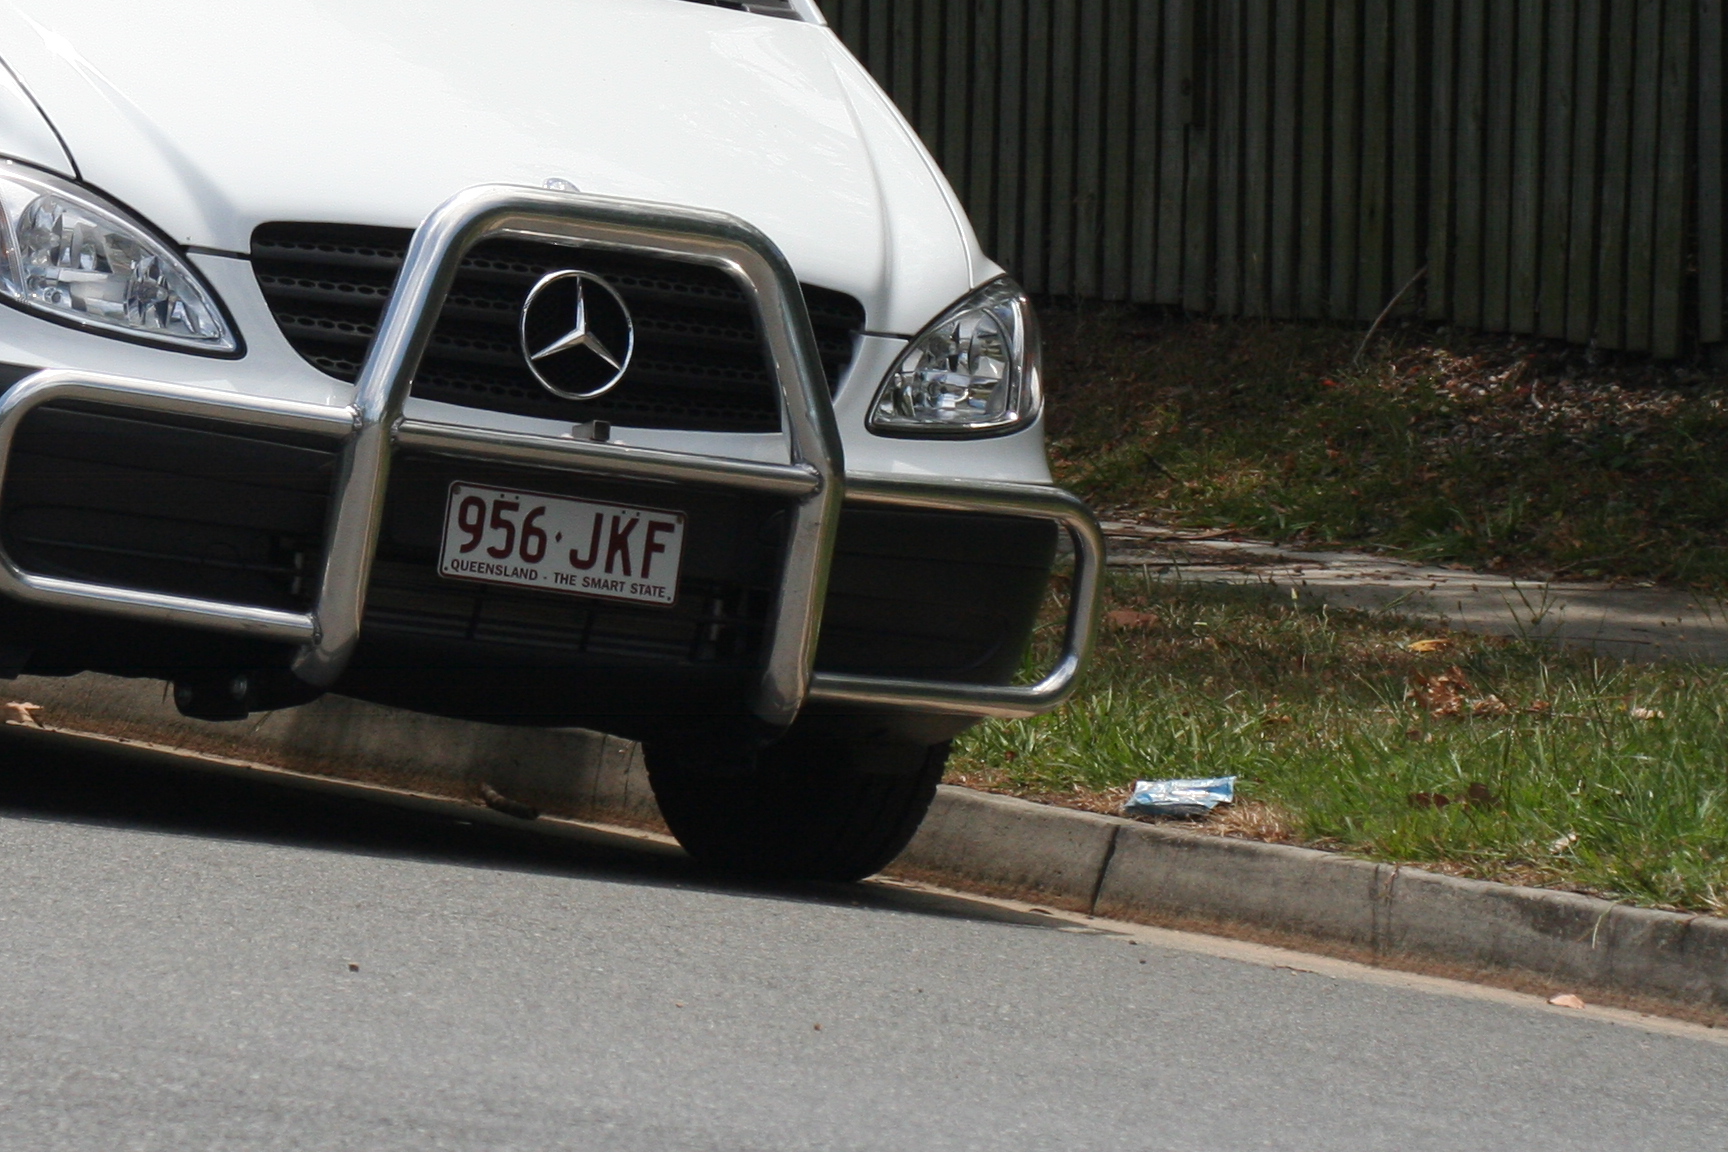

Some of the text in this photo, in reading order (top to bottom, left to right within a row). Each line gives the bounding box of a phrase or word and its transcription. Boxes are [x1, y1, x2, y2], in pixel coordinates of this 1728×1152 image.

[451, 558, 538, 581] QUEENSLAND
[553, 571, 576, 586] THE
[582, 576, 625, 593] SMART
[630, 582, 666, 599] STATE
